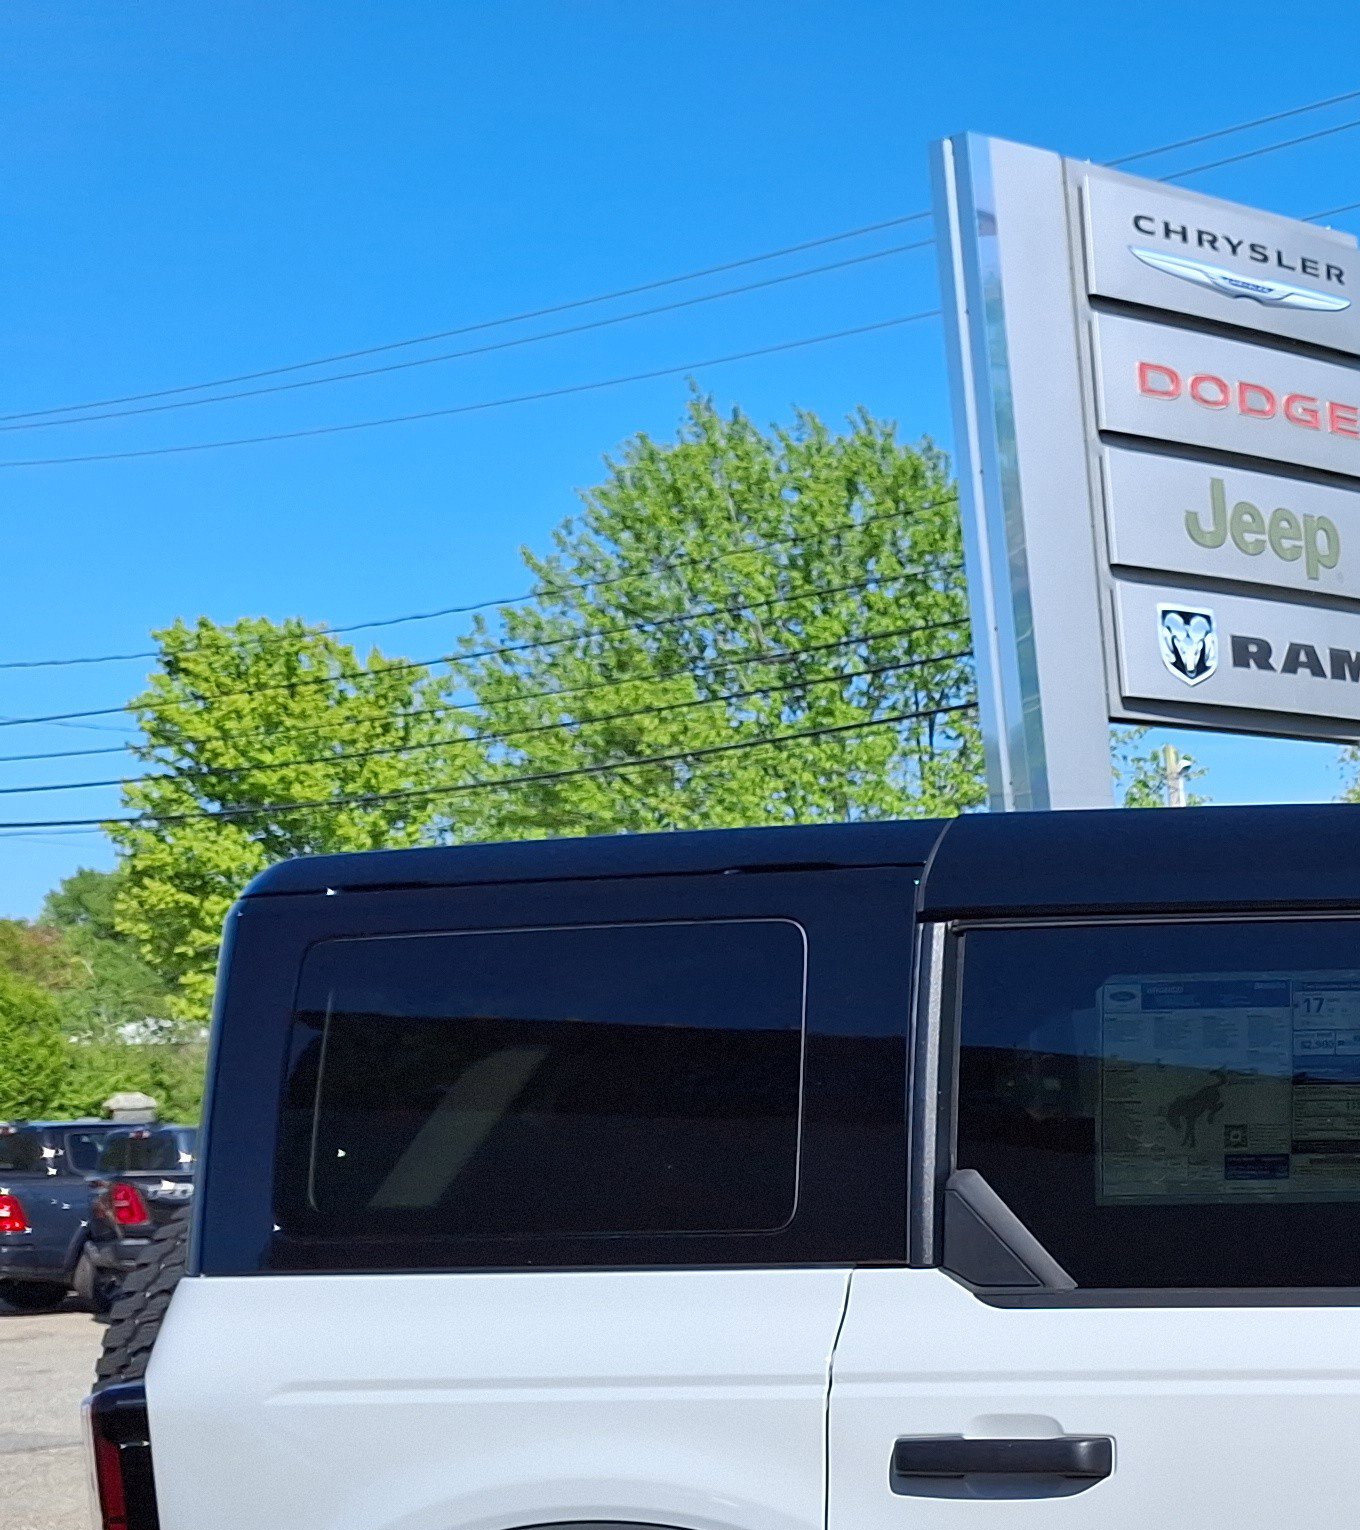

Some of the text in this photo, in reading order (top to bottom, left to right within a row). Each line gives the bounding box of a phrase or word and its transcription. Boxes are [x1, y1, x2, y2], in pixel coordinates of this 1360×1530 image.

[1133, 213, 1346, 285] CHRYSLER
[1136, 361, 1360, 438] DODGE
[1184, 476, 1341, 581] Jeep
[1303, 998, 1325, 1014] 17
